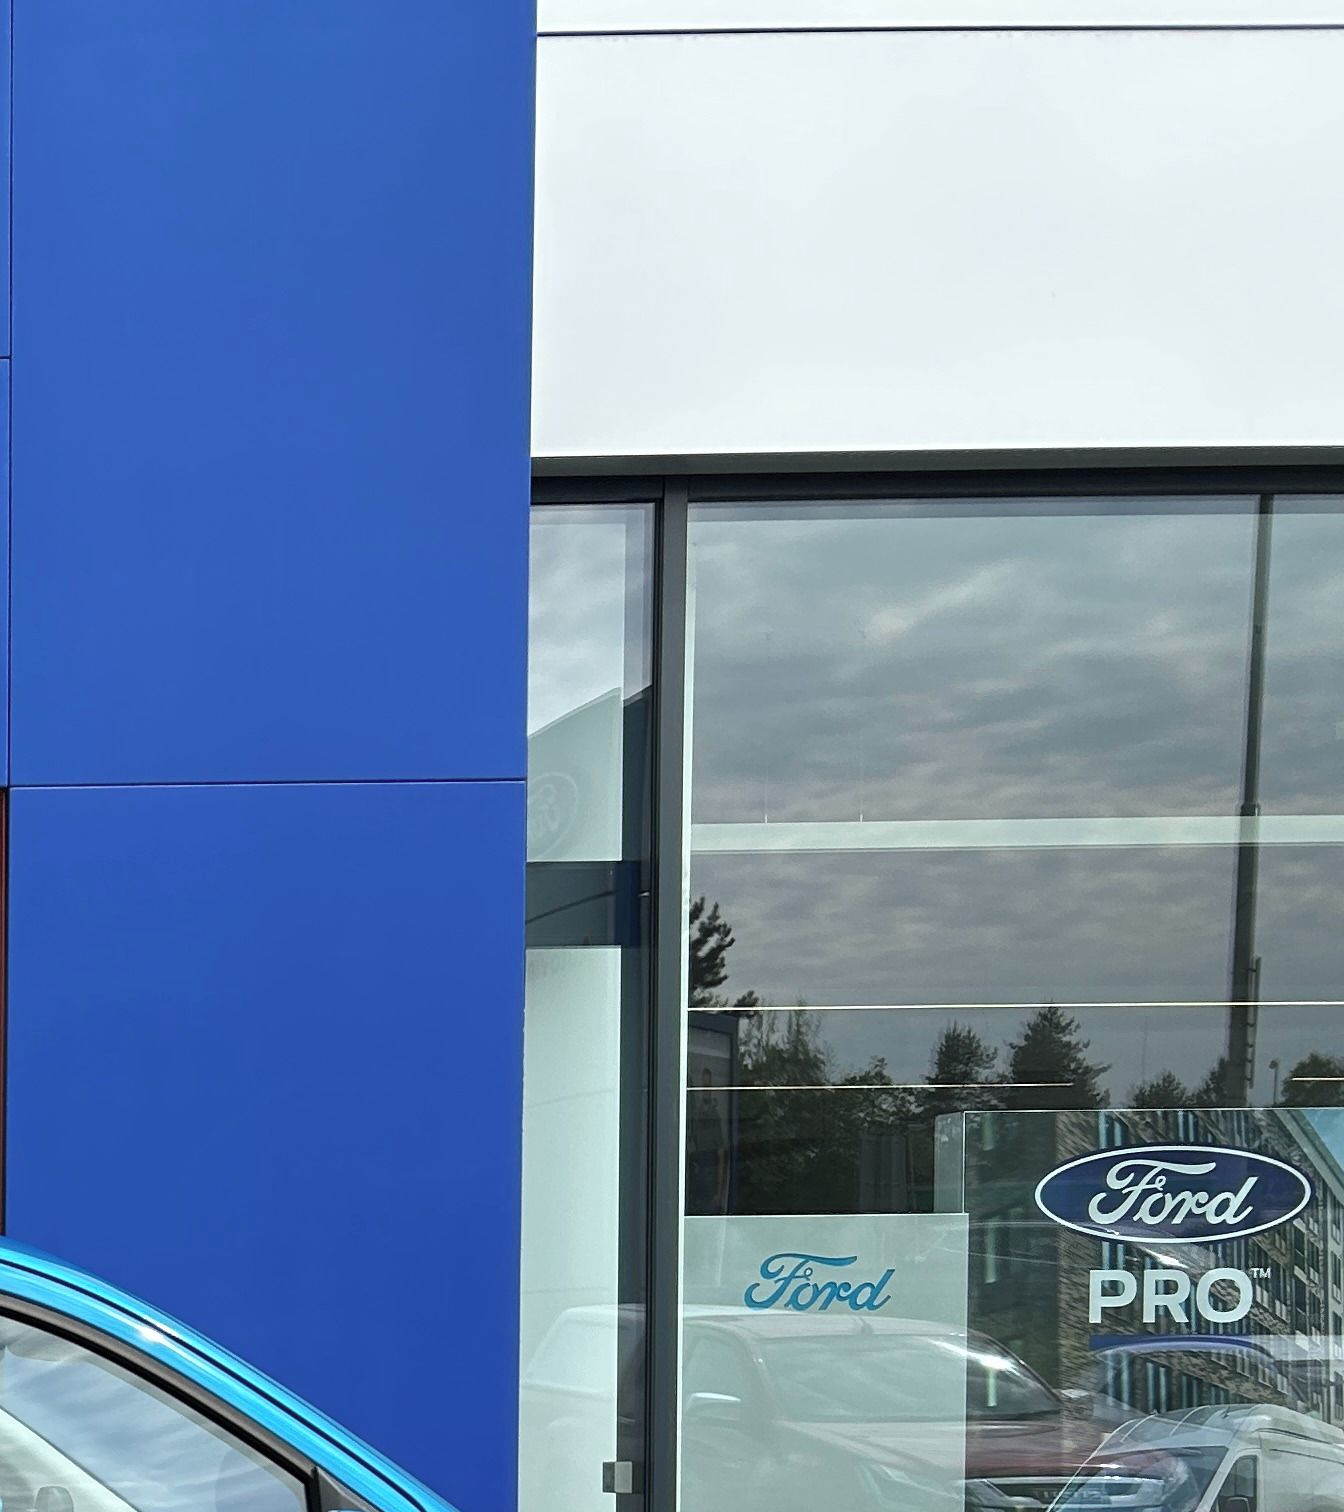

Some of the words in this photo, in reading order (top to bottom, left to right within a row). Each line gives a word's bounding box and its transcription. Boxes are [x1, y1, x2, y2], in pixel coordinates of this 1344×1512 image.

[1088, 1159, 1259, 1225] Ford
[743, 1252, 896, 1311] Ford
[1088, 1267, 1254, 1324] PRO
